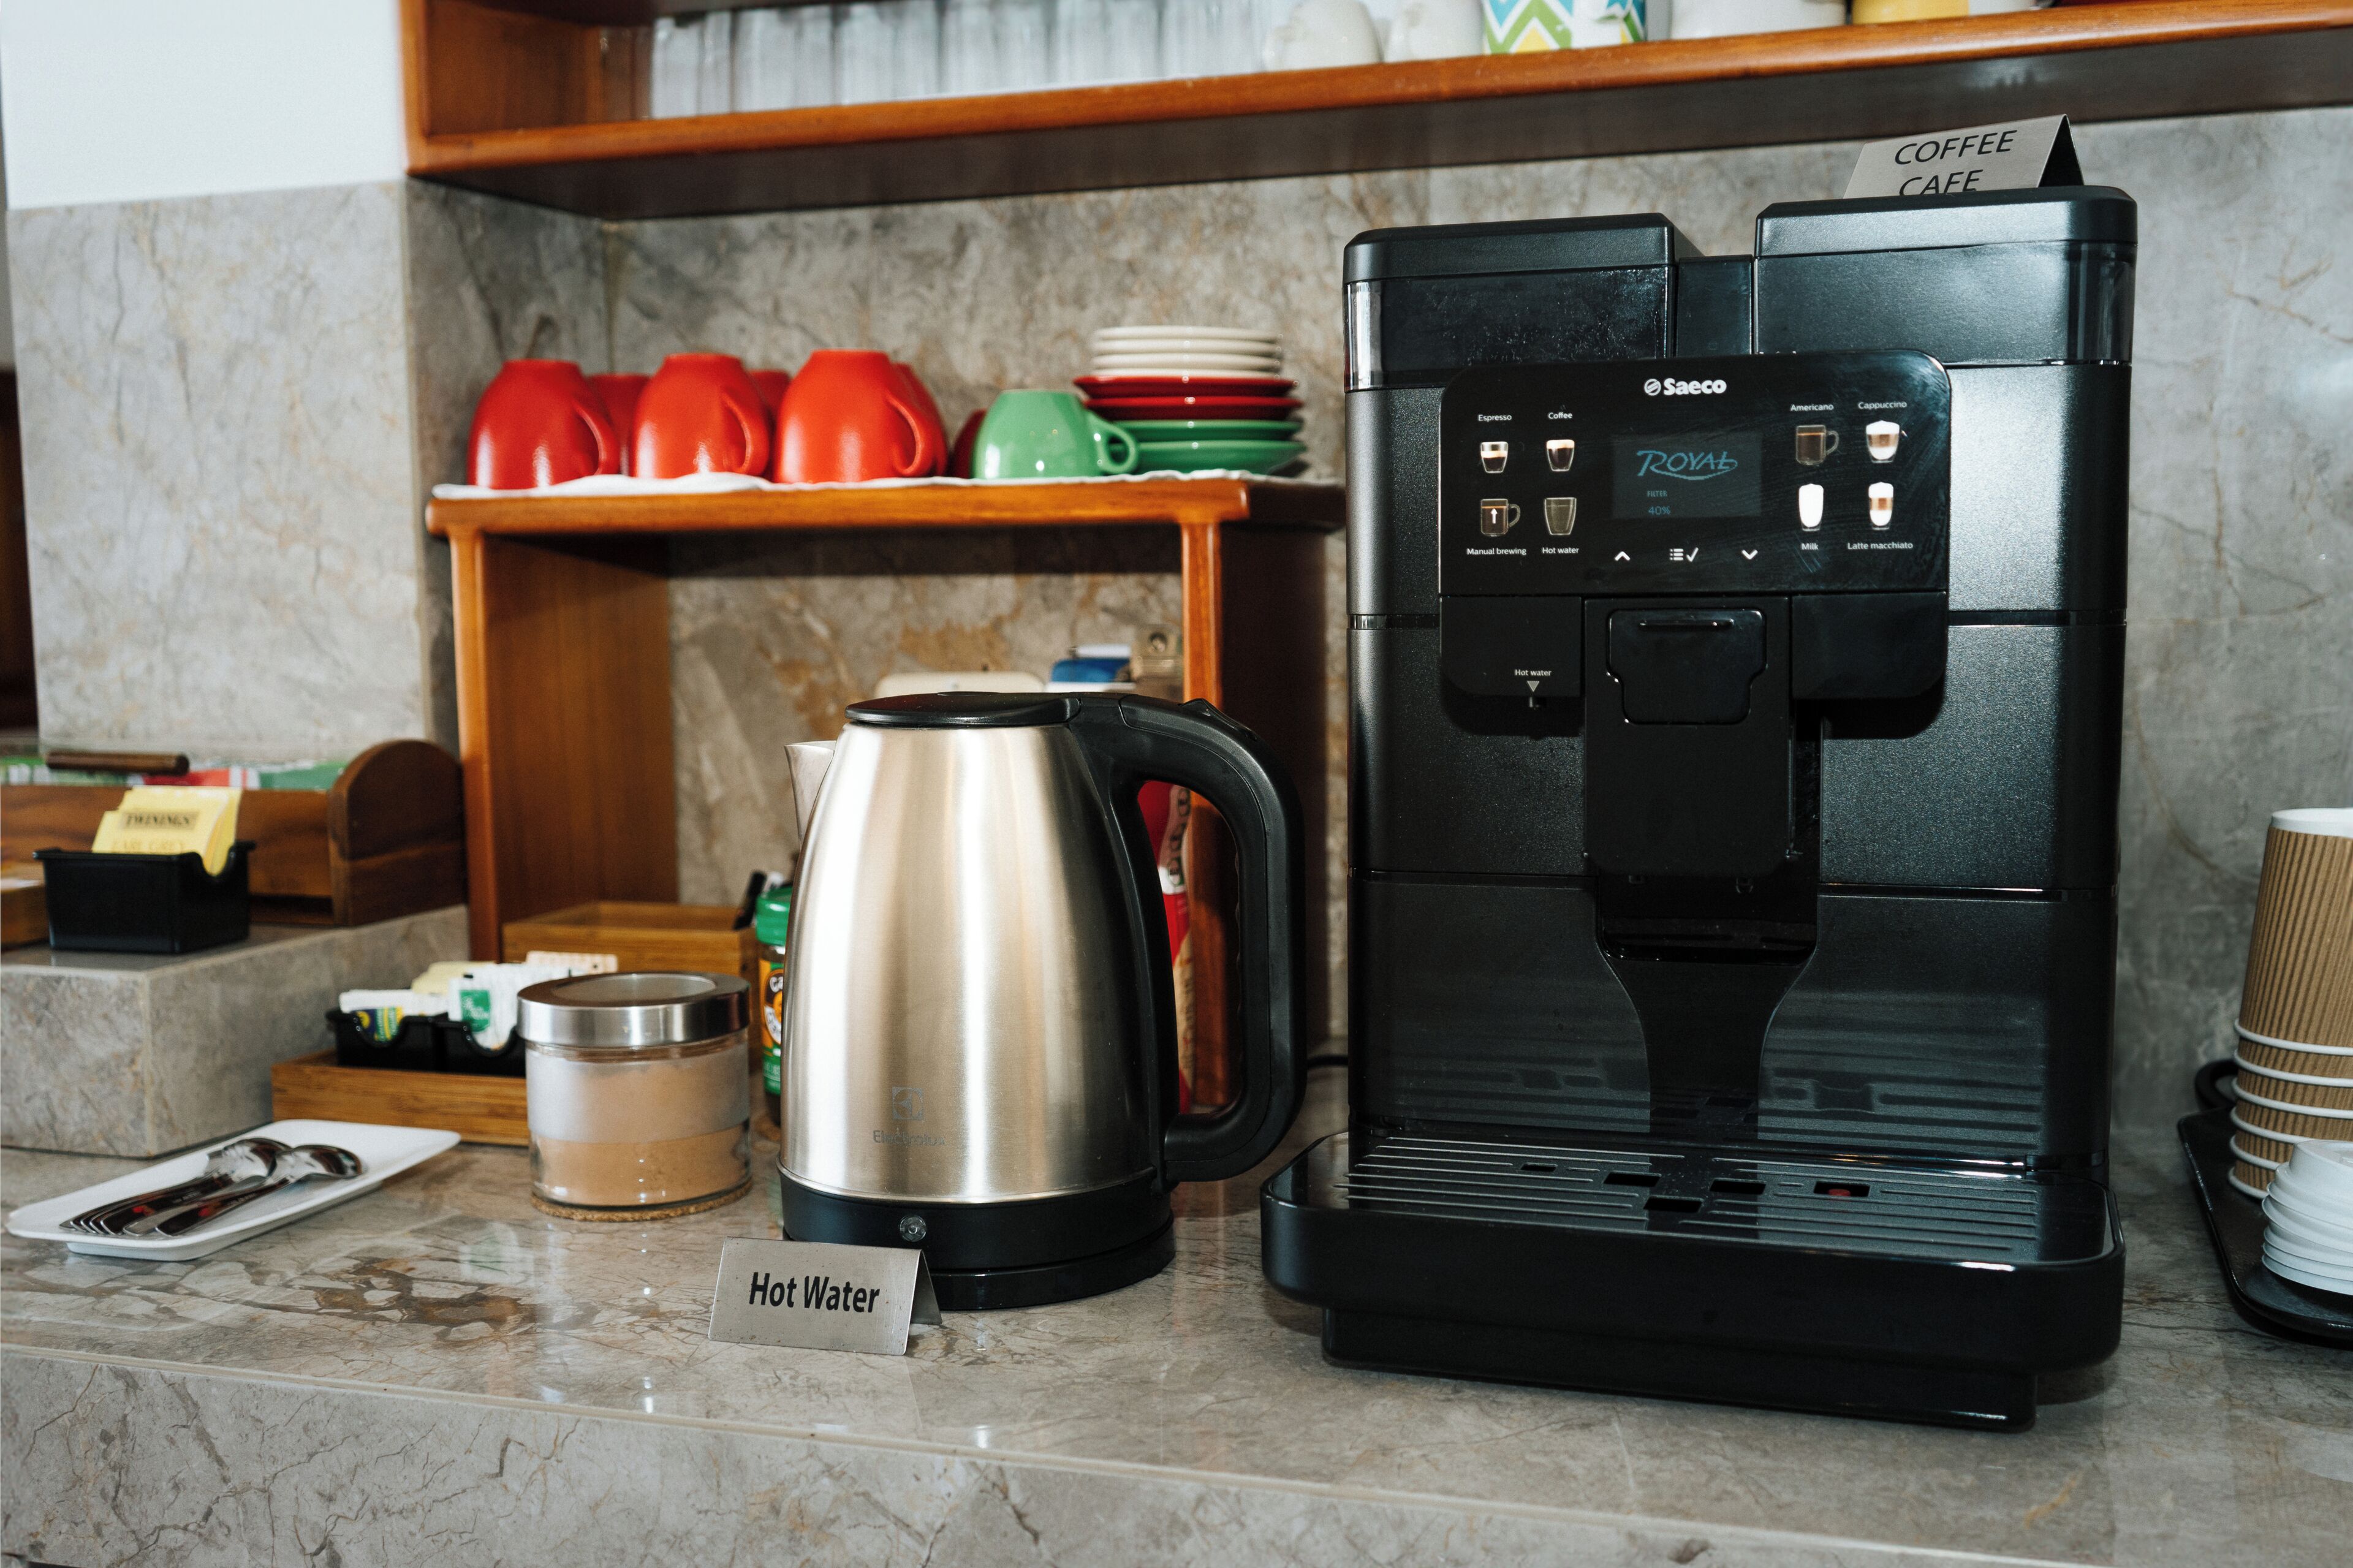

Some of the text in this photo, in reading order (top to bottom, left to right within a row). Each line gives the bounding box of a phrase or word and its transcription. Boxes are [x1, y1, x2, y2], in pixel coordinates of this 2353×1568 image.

[1895, 130, 2018, 165] COFFEE
[1899, 169, 1984, 197] CAFE
[1663, 377, 1727, 396] Saeco
[1790, 403, 1835, 412] Americano
[1857, 401, 1908, 410] Cappuccino
[1636, 450, 1738, 480] ROYAL
[1648, 506, 1671, 515] 40%
[1496, 547, 1527, 556] brewing
[749, 1271, 881, 1313] Hot Water
